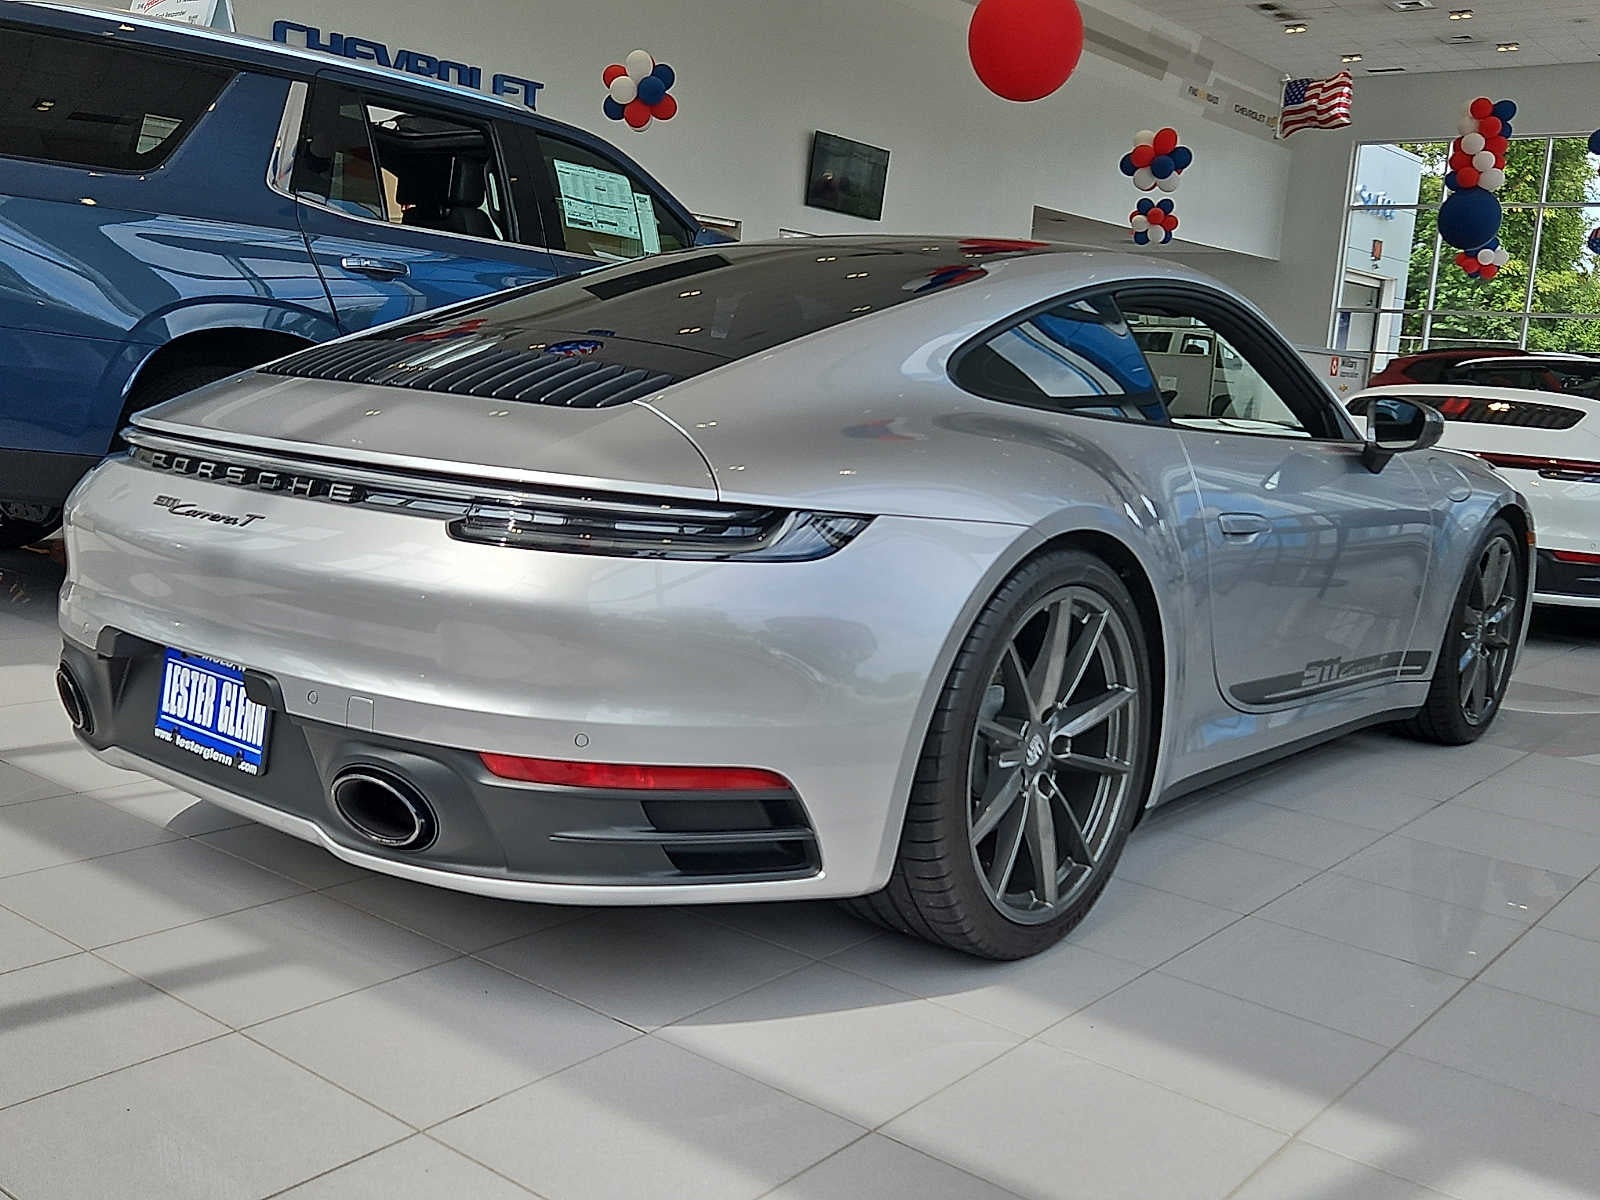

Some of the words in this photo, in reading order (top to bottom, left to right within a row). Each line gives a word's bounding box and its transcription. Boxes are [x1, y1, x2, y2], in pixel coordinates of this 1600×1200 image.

[151, 451, 356, 503] PORSCHE
[169, 503, 239, 526] Carrera
[239, 513, 266, 527] T
[162, 662, 217, 729] LESTER
[217, 681, 267, 747] GLENN
